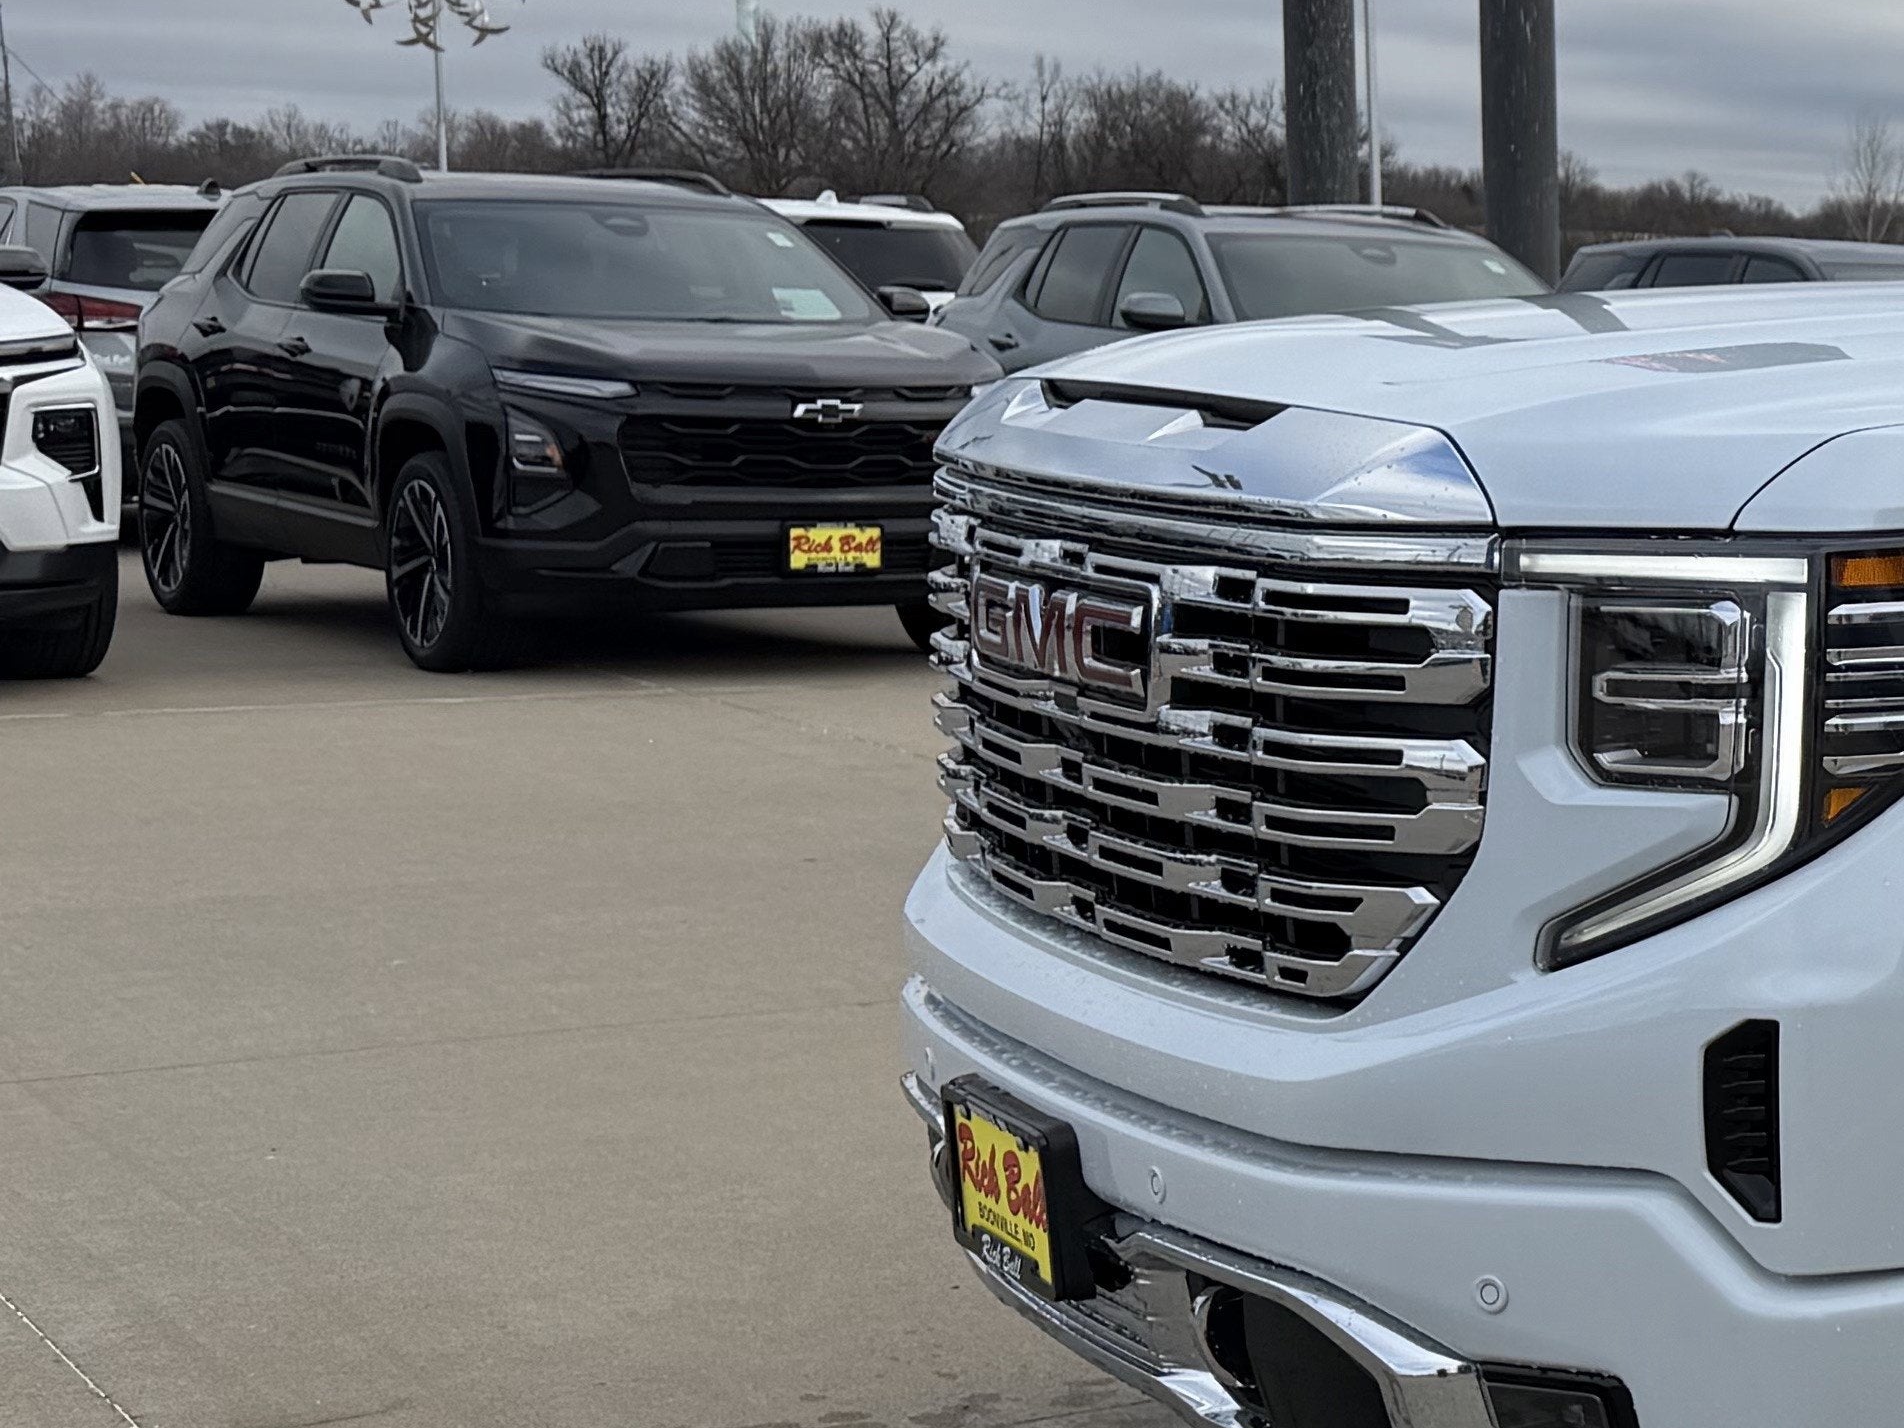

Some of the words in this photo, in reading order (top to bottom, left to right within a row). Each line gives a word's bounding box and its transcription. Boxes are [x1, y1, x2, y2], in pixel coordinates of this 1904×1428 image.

[791, 534, 834, 555] Rick
[838, 533, 881, 555] Ball
[972, 573, 1146, 698] GMC
[958, 1121, 1001, 1206] Rick
[1002, 1149, 1049, 1234] Ball
